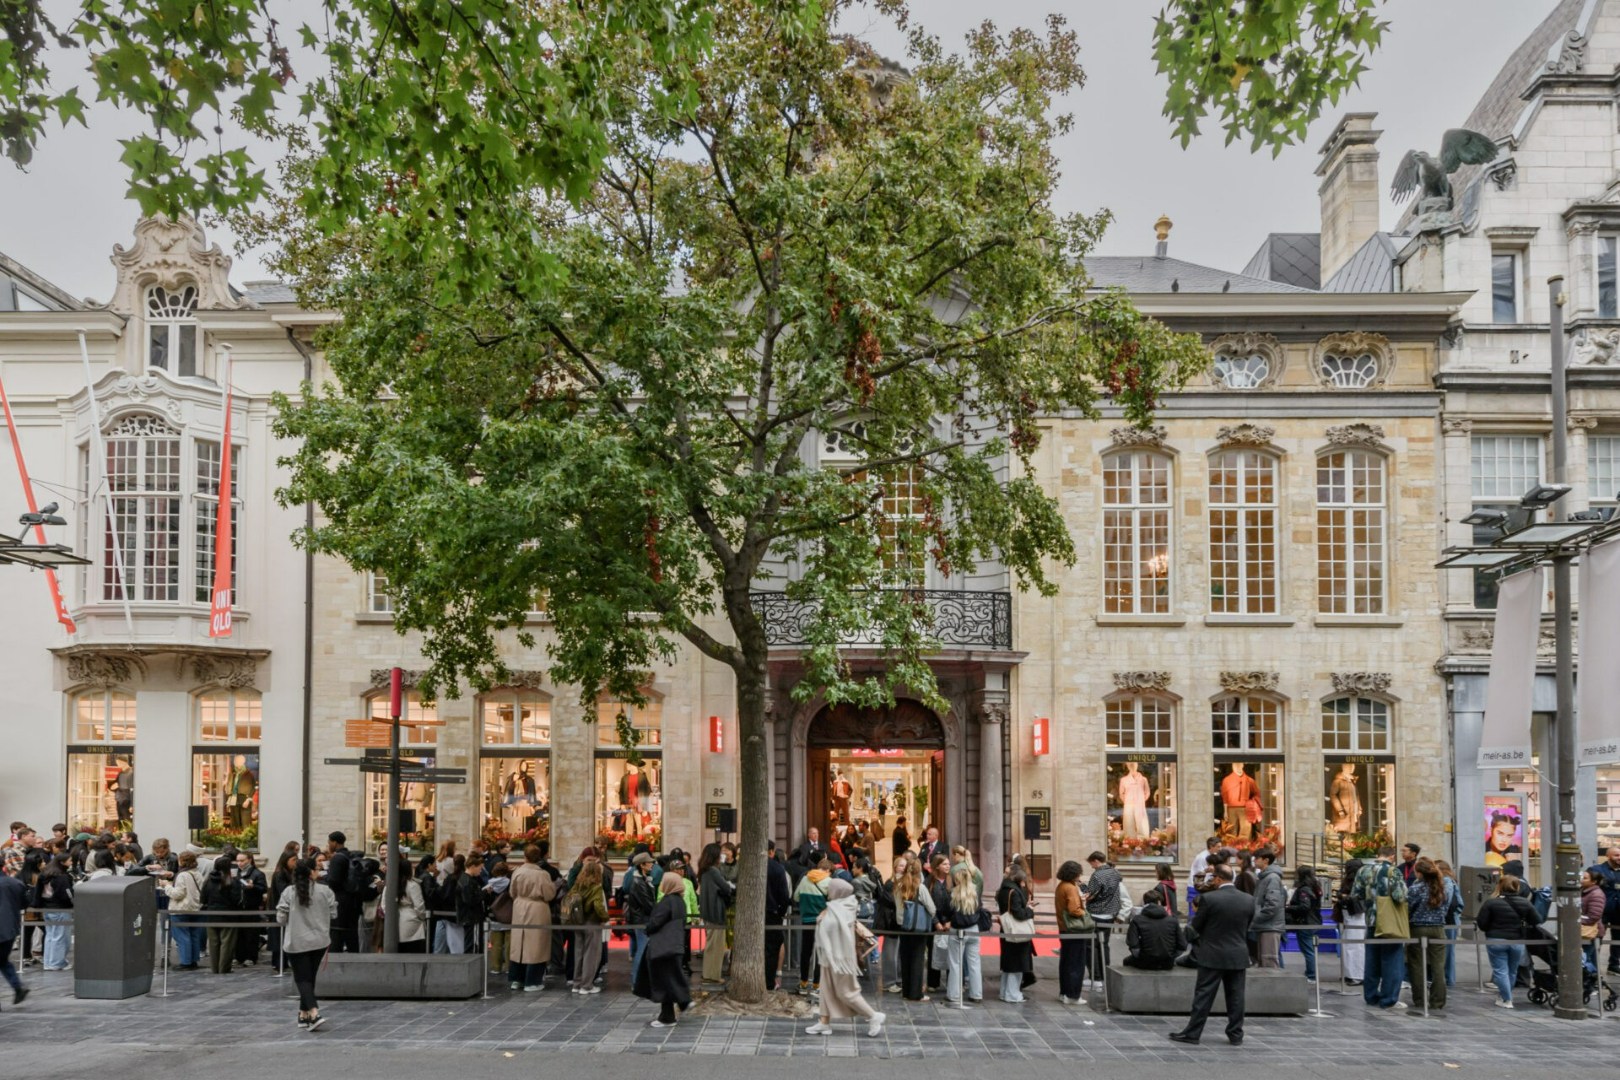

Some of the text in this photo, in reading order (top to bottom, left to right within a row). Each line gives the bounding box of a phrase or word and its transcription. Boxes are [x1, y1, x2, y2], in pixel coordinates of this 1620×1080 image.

[215, 588, 231, 610] UNI
[213, 611, 231, 635] QLO
[87, 746, 114, 754] UNIQLO
[386, 749, 414, 757] UQLO
[1482, 750, 1524, 760] meir-as.be
[1583, 744, 1617, 757] meir-as.be
[1127, 754, 1156, 763] UNIQLO
[1345, 755, 1375, 763] UNIQLO
[713, 788, 725, 798] 85
[1031, 789, 1043, 799] 85
